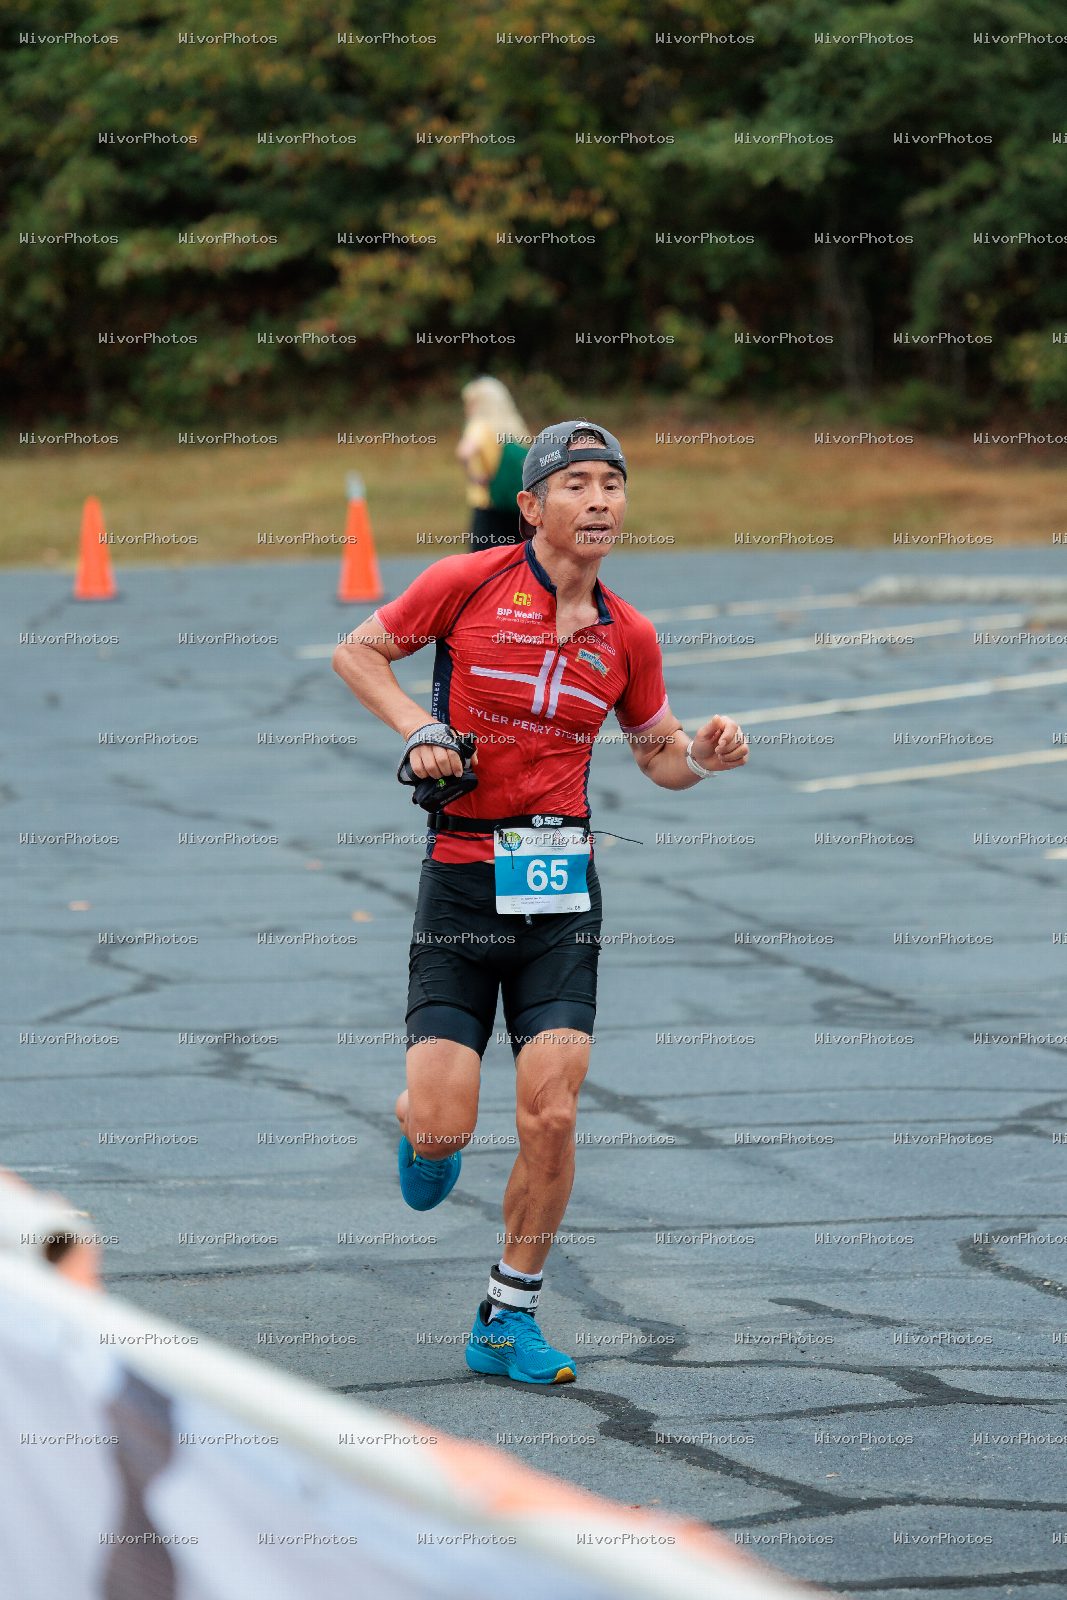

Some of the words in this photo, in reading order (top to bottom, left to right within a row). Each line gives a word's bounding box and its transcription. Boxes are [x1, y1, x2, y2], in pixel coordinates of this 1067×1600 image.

[496, 607, 512, 616] BIP
[513, 609, 543, 620] Wealth
[467, 705, 509, 725] TYLER
[512, 718, 554, 736] PERRY
[526, 859, 569, 892] 65
[492, 1286, 503, 1298] 65
